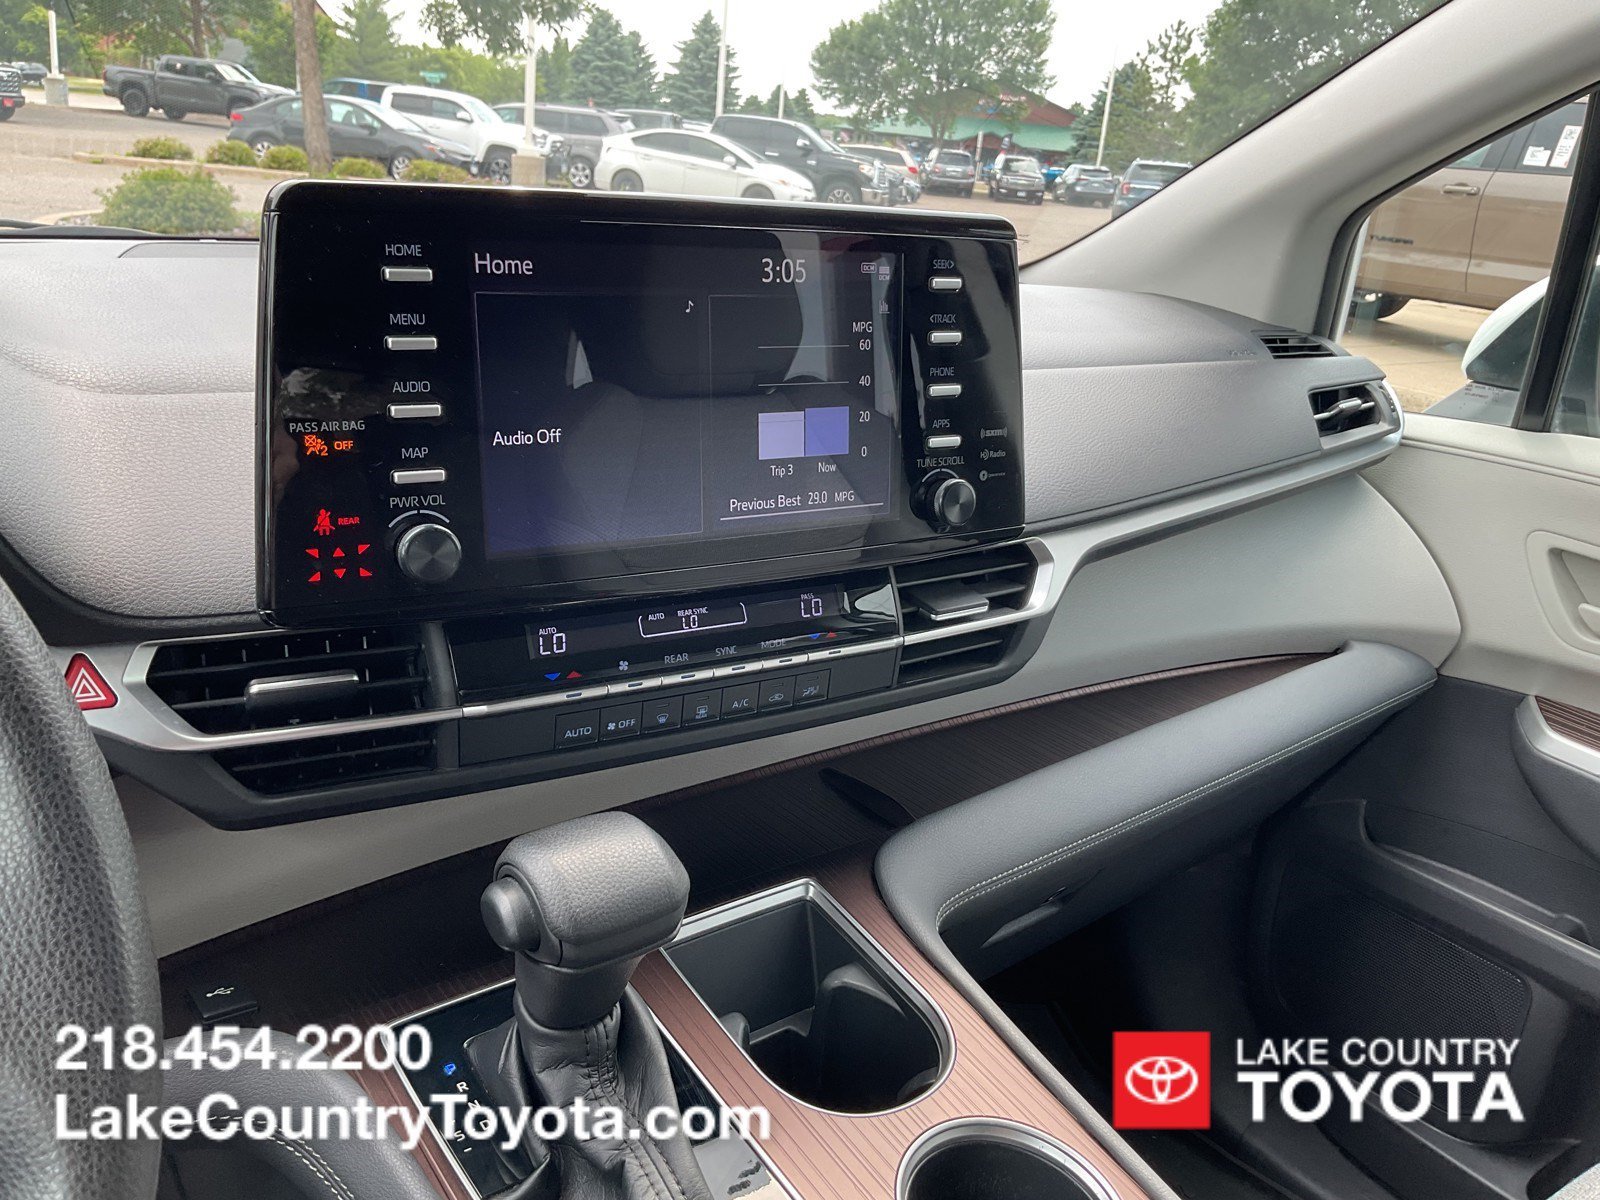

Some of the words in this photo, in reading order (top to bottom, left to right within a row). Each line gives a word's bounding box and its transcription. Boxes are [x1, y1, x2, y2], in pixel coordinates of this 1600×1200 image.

[385, 244, 422, 257] HOME
[474, 252, 533, 275] Home
[761, 258, 806, 283] 3:05
[389, 313, 425, 325] MENU
[852, 321, 873, 333] MPG
[859, 339, 871, 351] 60
[929, 366, 955, 377] PHONE
[858, 375, 871, 386] 40
[392, 381, 431, 393] AUDIO
[859, 411, 870, 422] 20
[289, 421, 318, 433] PASS
[320, 421, 340, 432] AIR
[342, 420, 366, 431] BAG
[932, 419, 950, 429] APPS
[492, 430, 534, 446] Audio
[536, 428, 562, 444] Off
[334, 440, 354, 450] OFF
[401, 447, 429, 459] MAP
[861, 446, 868, 457] 0
[990, 450, 1006, 458] Radio
[818, 462, 837, 473] Now
[916, 457, 937, 468] TUNE
[938, 455, 965, 467] SCROLL
[770, 465, 786, 478] Trip
[787, 464, 794, 476] 3
[389, 496, 419, 509] PWR
[421, 494, 446, 506] VOL
[729, 498, 775, 512] Previous
[777, 494, 802, 507] Best
[808, 491, 828, 505] 29.0
[834, 490, 855, 503] MPG
[337, 516, 360, 526] REAR
[800, 592, 815, 600] PASS
[648, 612, 665, 621] AUTO
[677, 608, 693, 617] REAR
[693, 607, 708, 615] SYNC
[538, 626, 557, 635] AUTO
[760, 638, 786, 650] MODE
[715, 645, 737, 657] SYNC
[664, 652, 689, 664] REAR
[732, 698, 749, 709] A/C
[618, 718, 636, 729] OFF
[564, 726, 592, 739] AUTO
[456, 1081, 470, 1093] R
